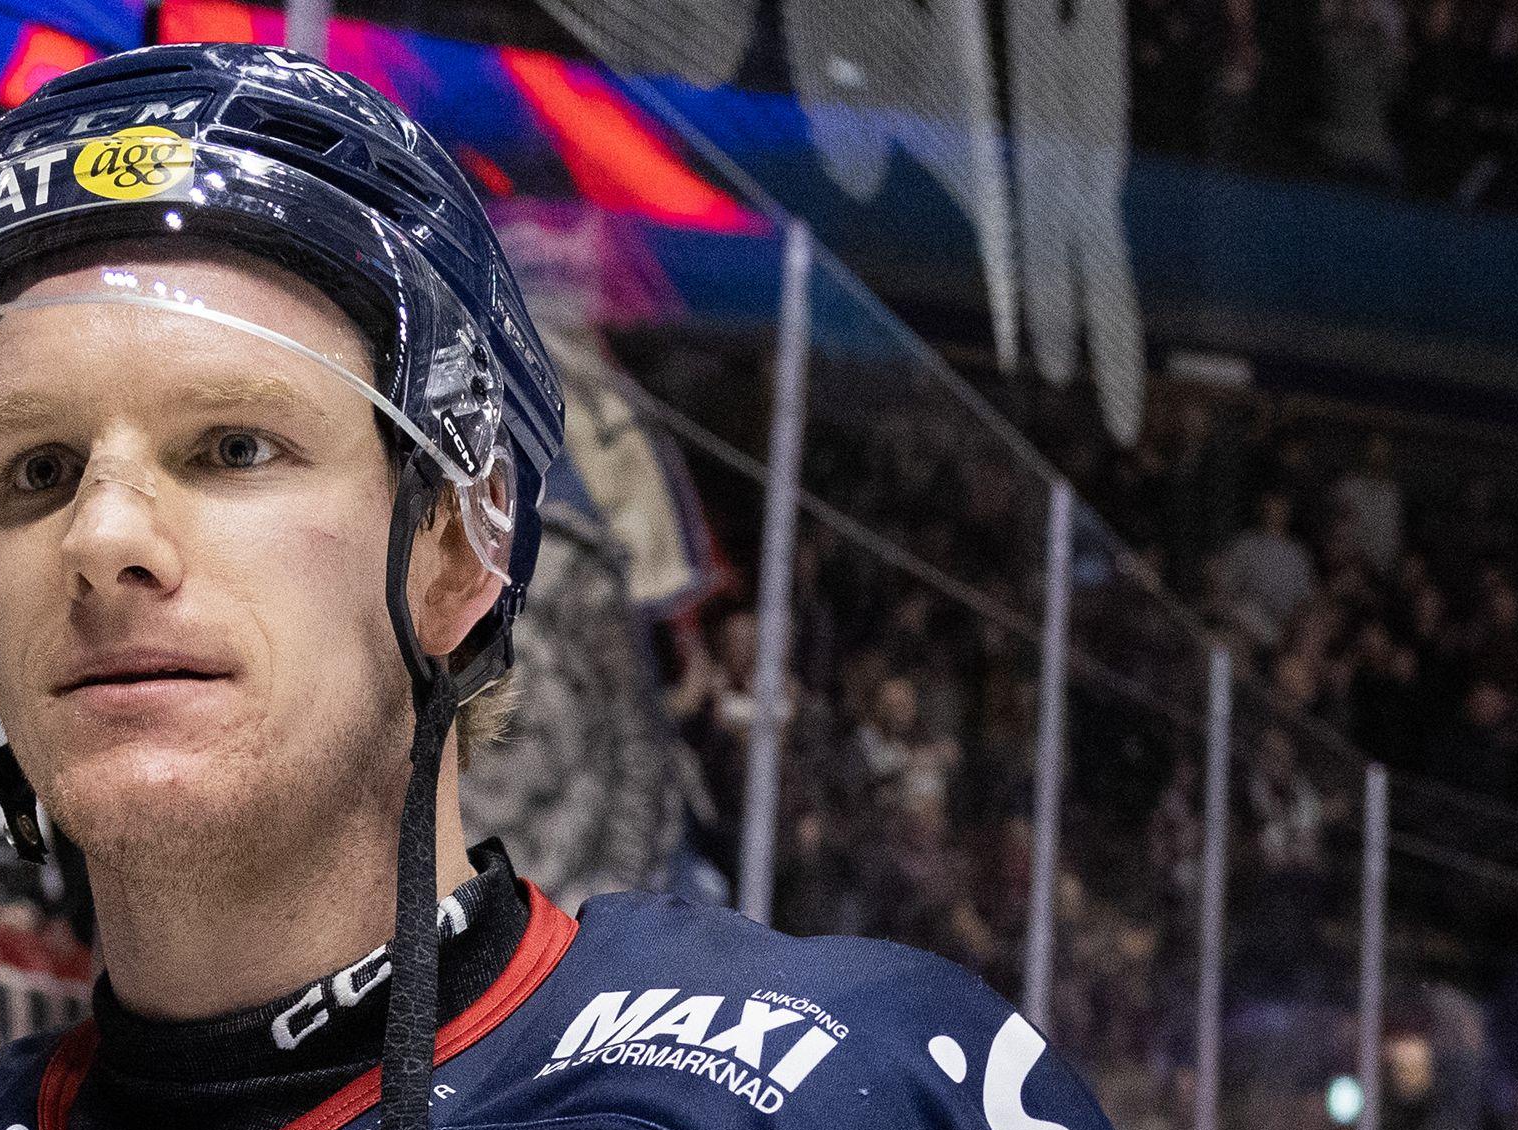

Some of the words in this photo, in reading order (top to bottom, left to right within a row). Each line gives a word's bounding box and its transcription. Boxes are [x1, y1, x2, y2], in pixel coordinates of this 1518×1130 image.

[90, 140, 183, 189] ägg
[442, 416, 476, 474] CCM
[550, 988, 839, 1094] MAXI
[750, 987, 851, 1041] LINKÖPING
[575, 1043, 785, 1115] STORMARKNAD
